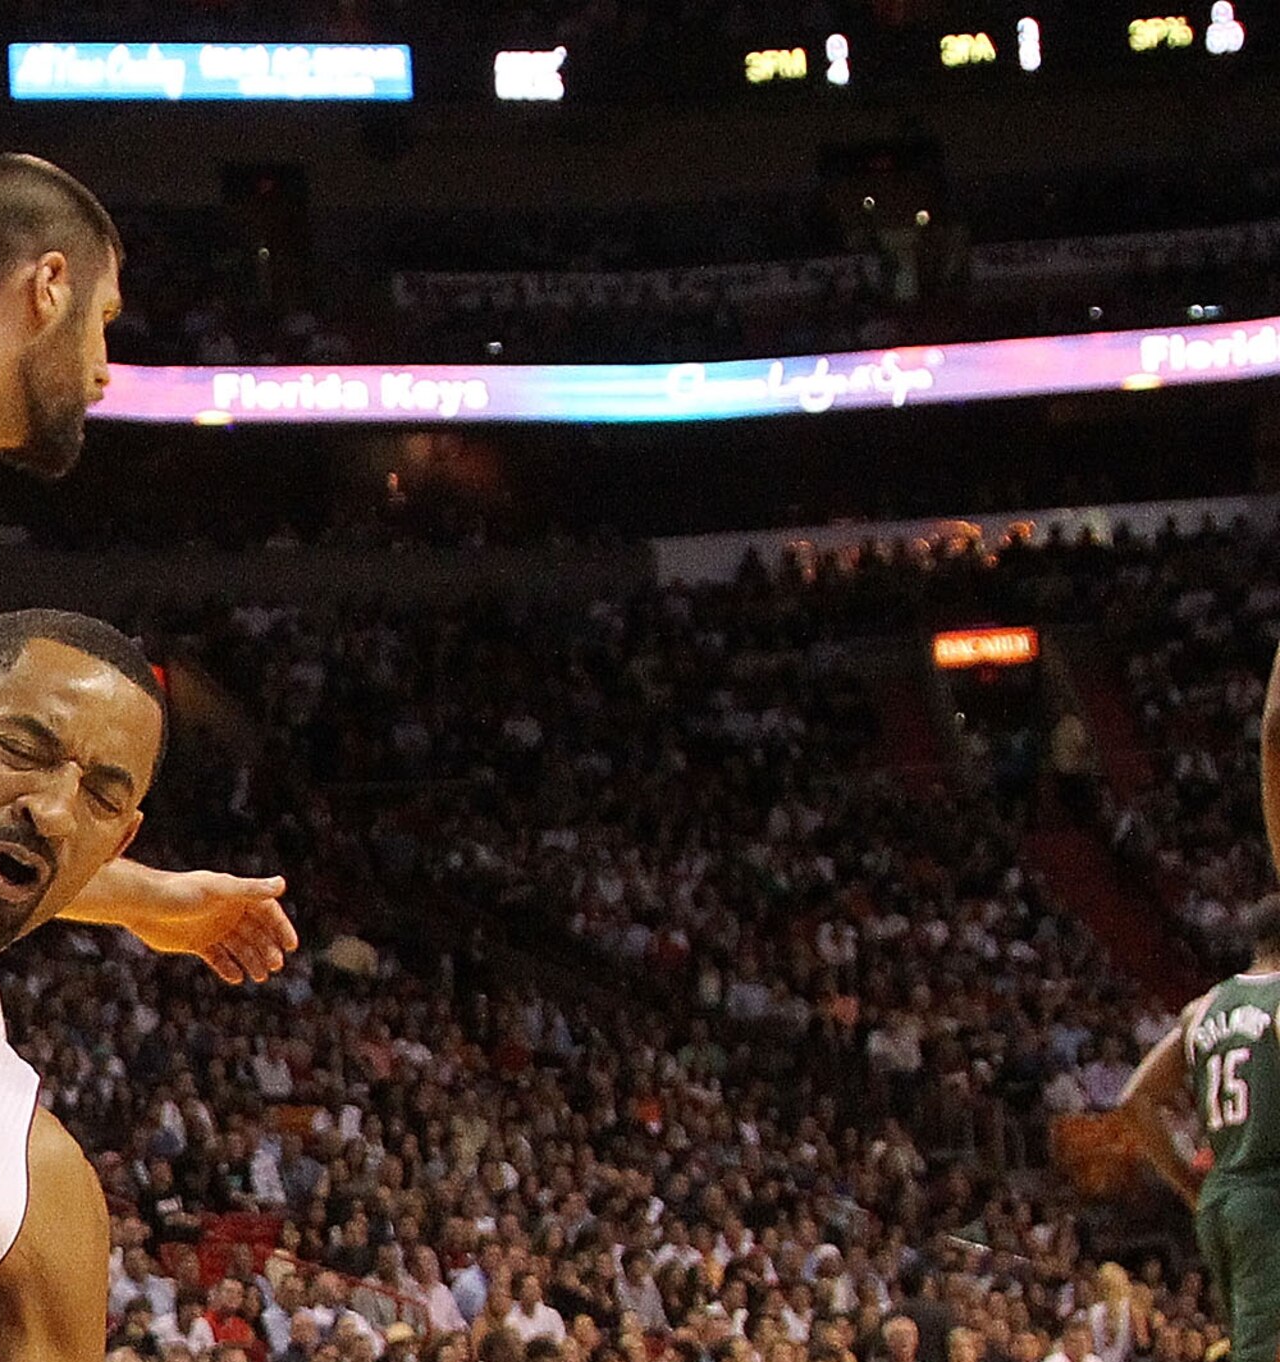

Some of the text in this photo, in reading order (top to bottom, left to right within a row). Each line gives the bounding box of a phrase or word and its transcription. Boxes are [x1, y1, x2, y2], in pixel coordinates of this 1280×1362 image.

[1141, 325, 1280, 372] Florid
[212, 373, 489, 418] Florida Keys
[1206, 1048, 1251, 1131] 15
